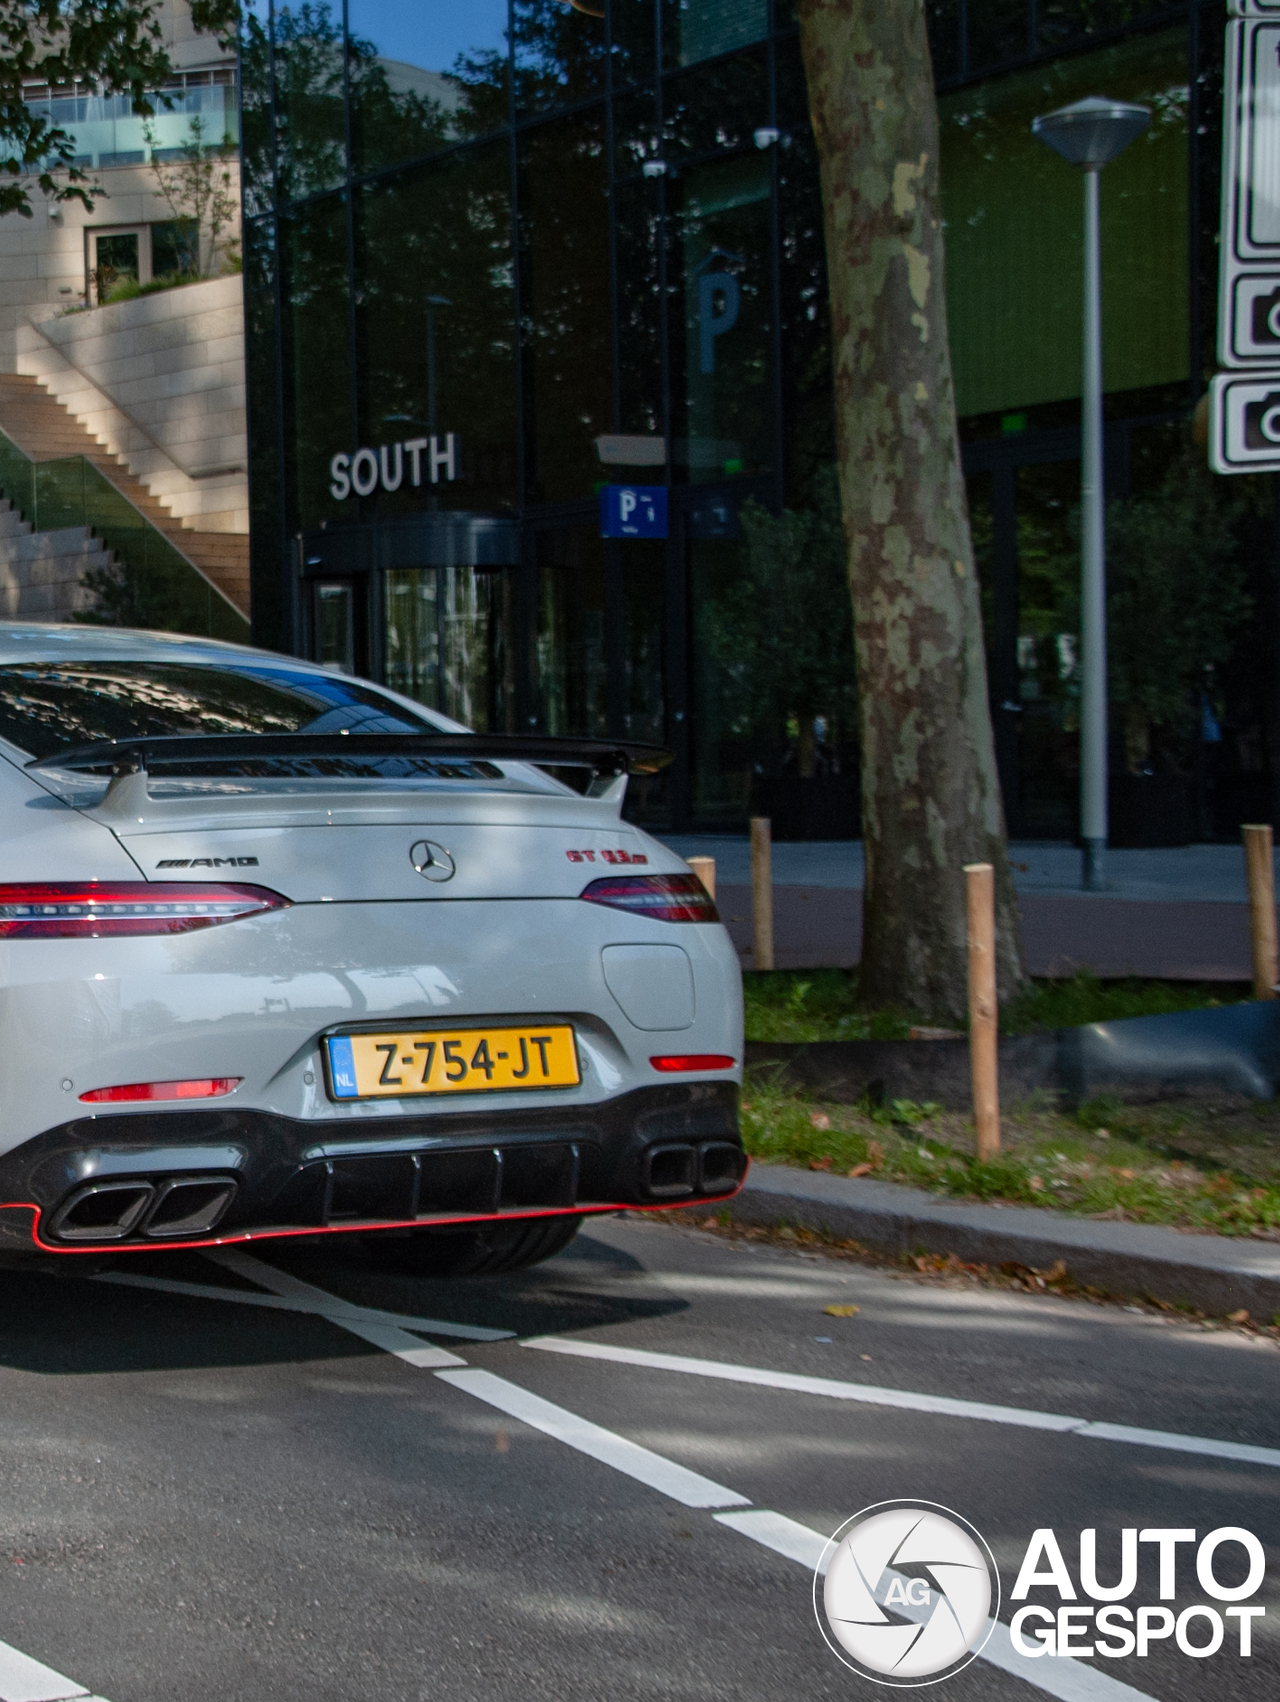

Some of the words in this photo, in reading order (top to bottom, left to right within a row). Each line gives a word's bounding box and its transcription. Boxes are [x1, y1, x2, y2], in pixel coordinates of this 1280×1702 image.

[699, 272, 740, 374] P
[330, 430, 456, 501] SOUTH
[620, 493, 637, 521] P
[566, 850, 595, 862] GT
[335, 1073, 354, 1087] NL
[375, 1036, 553, 1086] Z-754-JT
